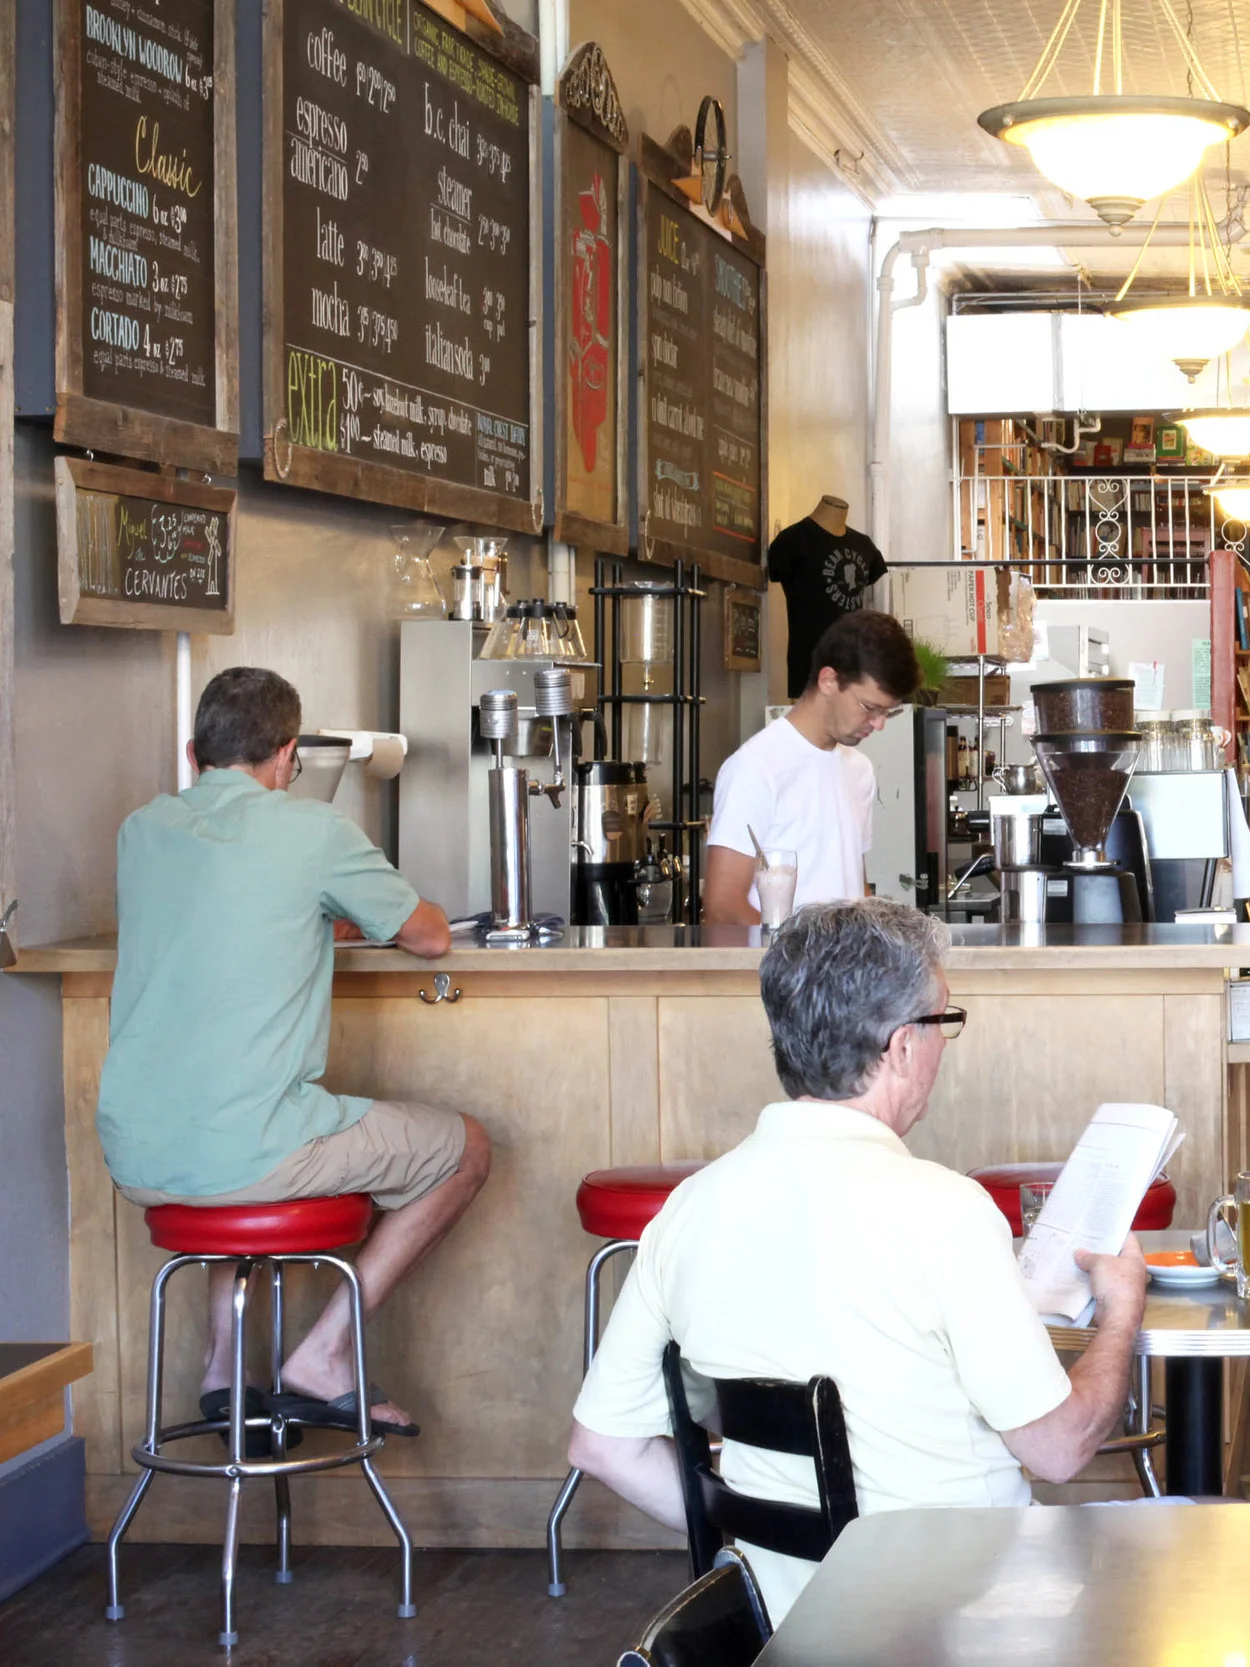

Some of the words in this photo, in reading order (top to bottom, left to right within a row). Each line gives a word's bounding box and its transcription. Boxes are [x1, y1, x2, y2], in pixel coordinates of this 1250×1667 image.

[86, 5, 136, 60] BROOKLYN
[139, 36, 182, 83] WOODROW
[307, 27, 347, 87] coffee
[296, 96, 347, 154] espresso
[449, 101, 470, 160] chai
[136, 115, 201, 197] Classic
[291, 138, 348, 201] americano
[88, 163, 149, 219] CAPPUCCINO
[153, 194, 159, 224] 6
[161, 210, 168, 226] oz
[438, 165, 472, 221] steamer
[90, 235, 148, 289] MACCHIATO
[152, 260, 159, 292] 3
[160, 278, 168, 292] oz
[317, 206, 344, 267] latte
[92, 282, 123, 305] espresso
[311, 280, 350, 337] mocha
[459, 277, 471, 315] tea
[91, 306, 140, 350] CORTADO
[143, 323, 150, 357] 4
[153, 343, 161, 358] oz
[425, 321, 455, 375] italian
[455, 336, 474, 380] soda
[288, 350, 338, 453] extra
[373, 423, 400, 454] steamed
[420, 442, 448, 471] espresso
[118, 506, 147, 560] Miguel
[135, 548, 146, 561] de
[124, 567, 187, 600] CERVANTES
[823, 549, 843, 576] BEAN
